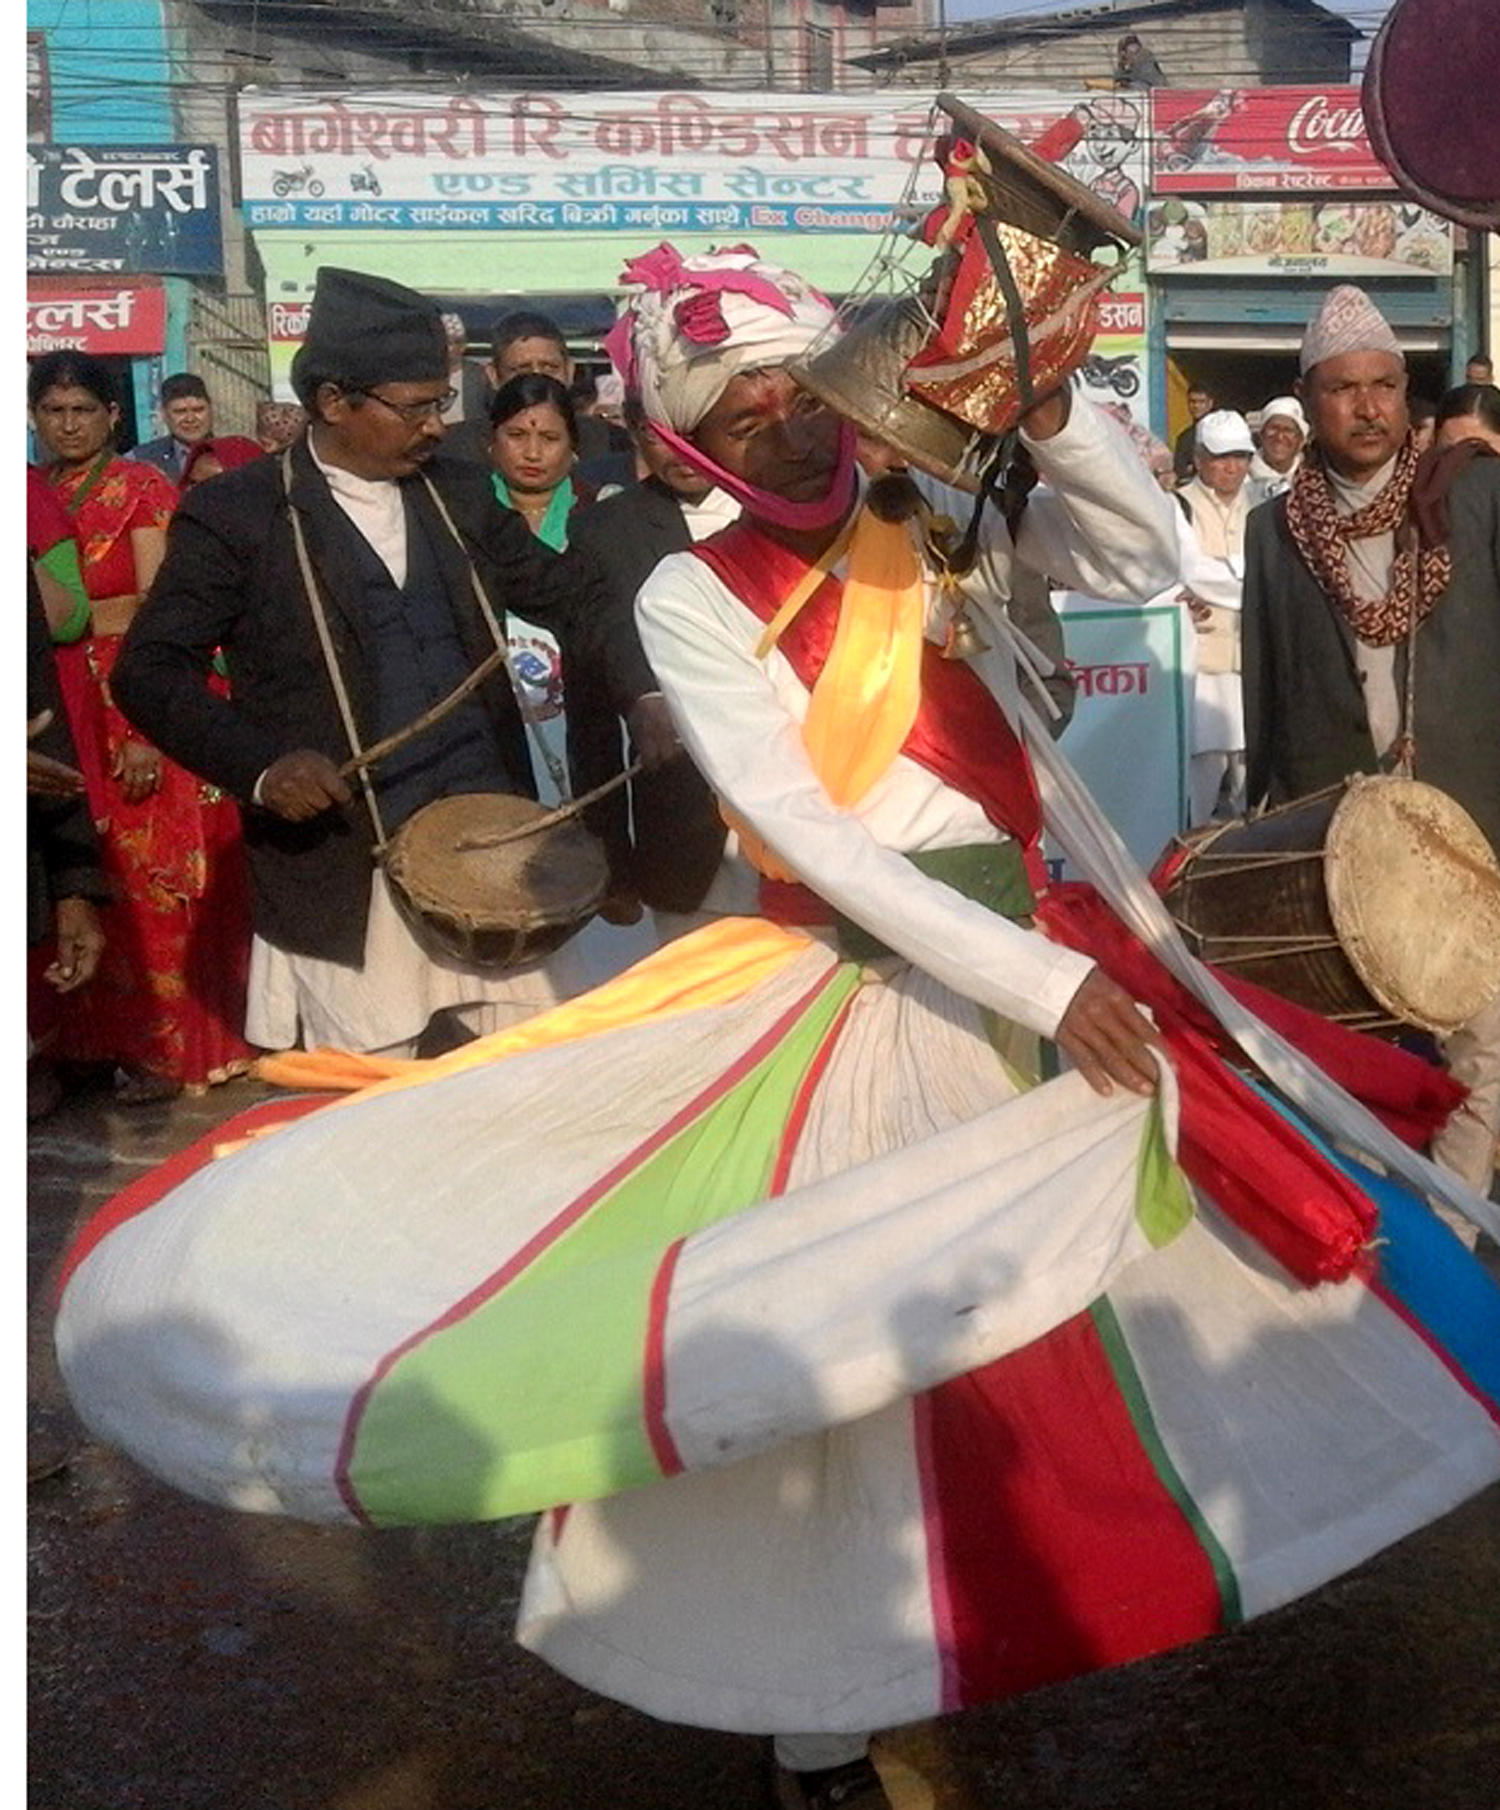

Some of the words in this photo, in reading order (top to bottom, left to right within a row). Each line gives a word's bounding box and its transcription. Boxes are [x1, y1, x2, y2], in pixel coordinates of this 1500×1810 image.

[250, 96, 493, 160] बागेश्वरी
[60, 147, 211, 213] टेलर्स
[432, 172, 537, 196] एण्ड
[723, 166, 873, 199] सेन्टर
[350, 204, 403, 223] मोटर
[28, 291, 137, 331] लर्स
